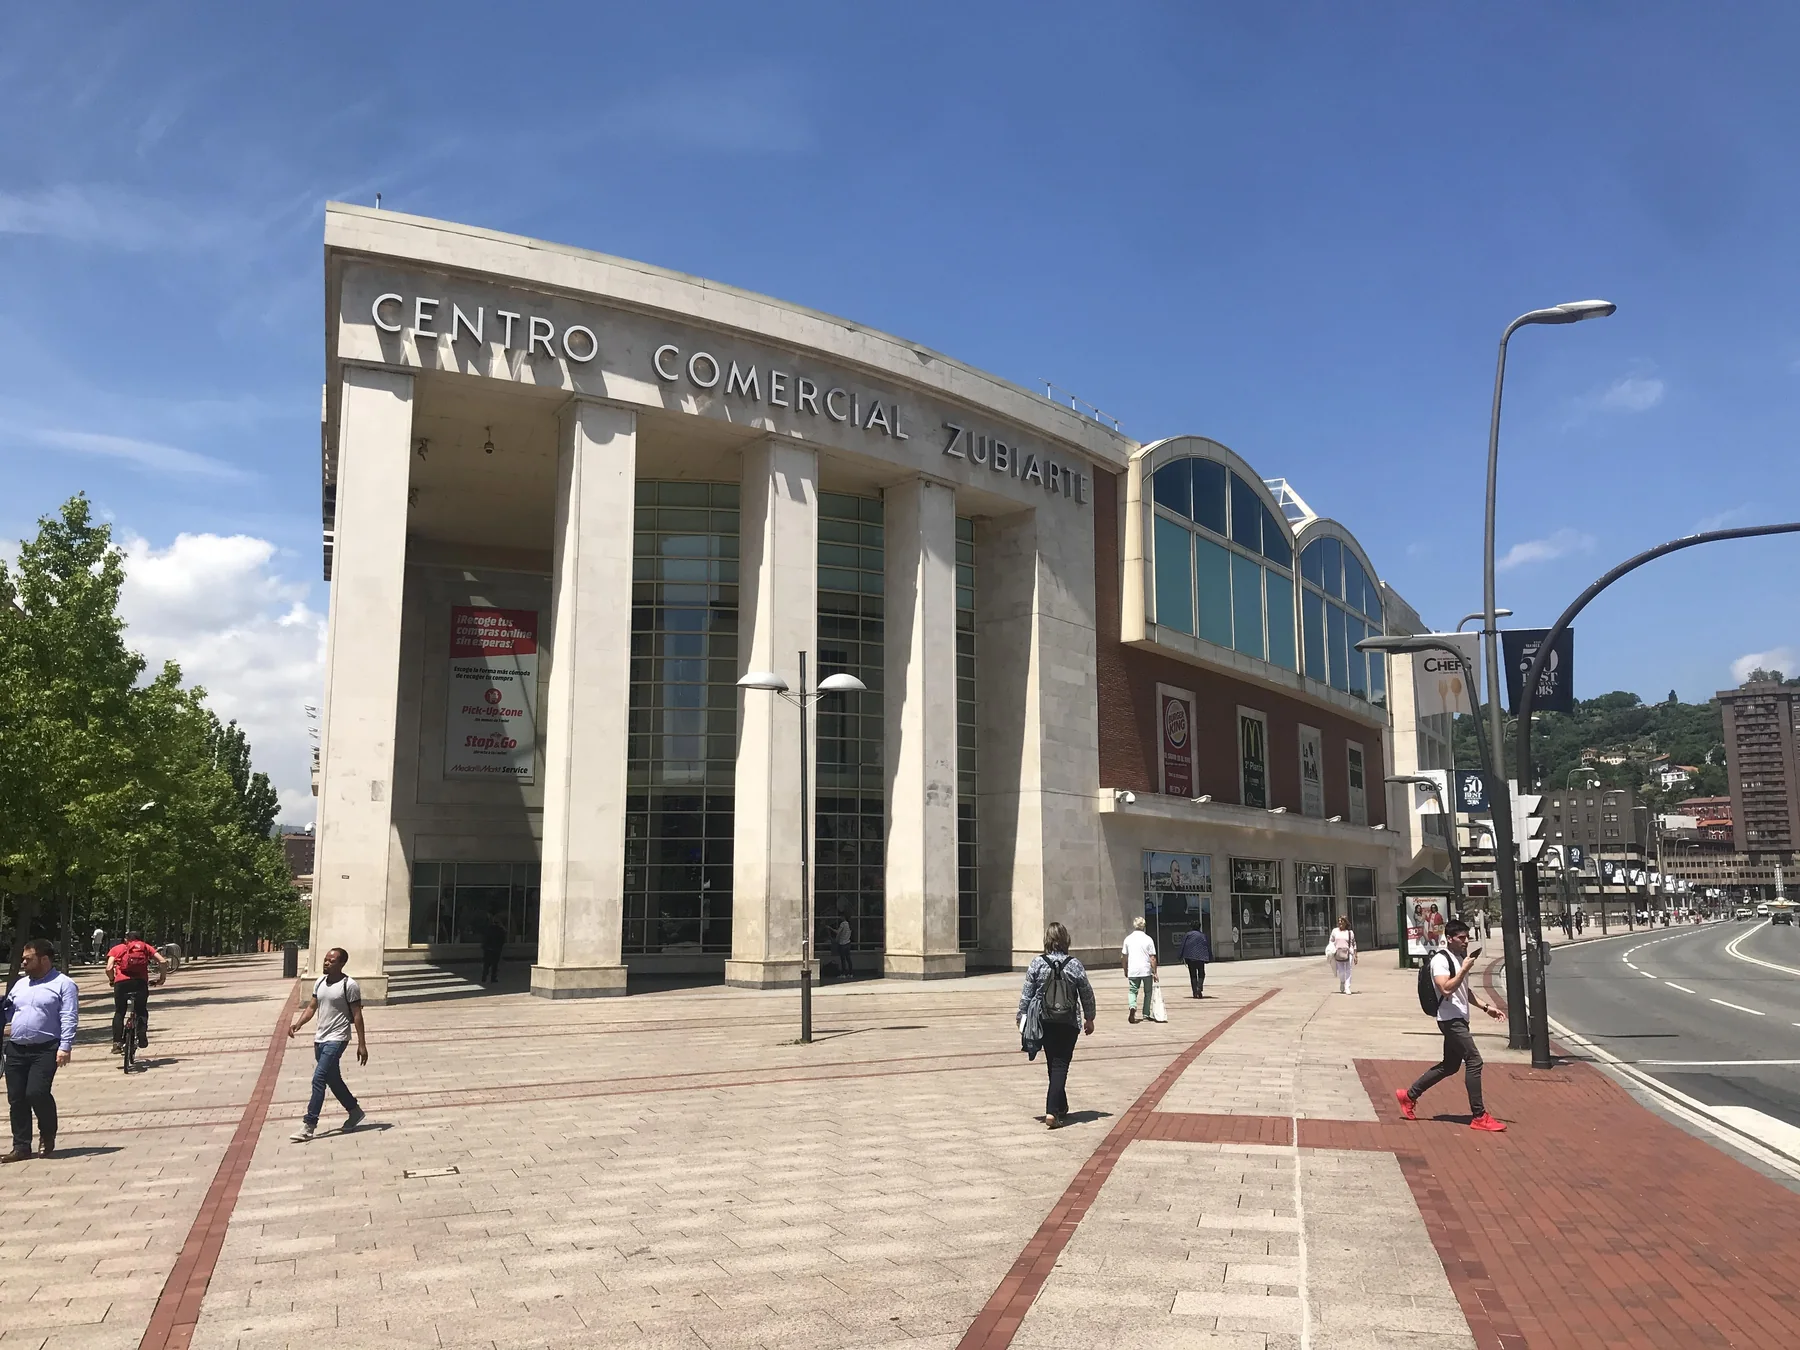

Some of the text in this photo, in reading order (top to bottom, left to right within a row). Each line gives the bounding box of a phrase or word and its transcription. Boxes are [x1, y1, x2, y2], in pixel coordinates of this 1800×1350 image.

[371, 293, 1088, 504] CENTRO COMERCIAL ZUBIARTE
[457, 615, 514, 628] ¡Recoge tus
[456, 627, 533, 639] compras online
[456, 636, 515, 649] sin esperas!
[462, 705, 523, 717] Pick-Up Zone
[1168, 710, 1185, 721] BURGER
[1168, 719, 1186, 735] KING
[501, 766, 529, 774] Service
[1463, 779, 1483, 793] 50
[1408, 928, 1418, 936] 30
